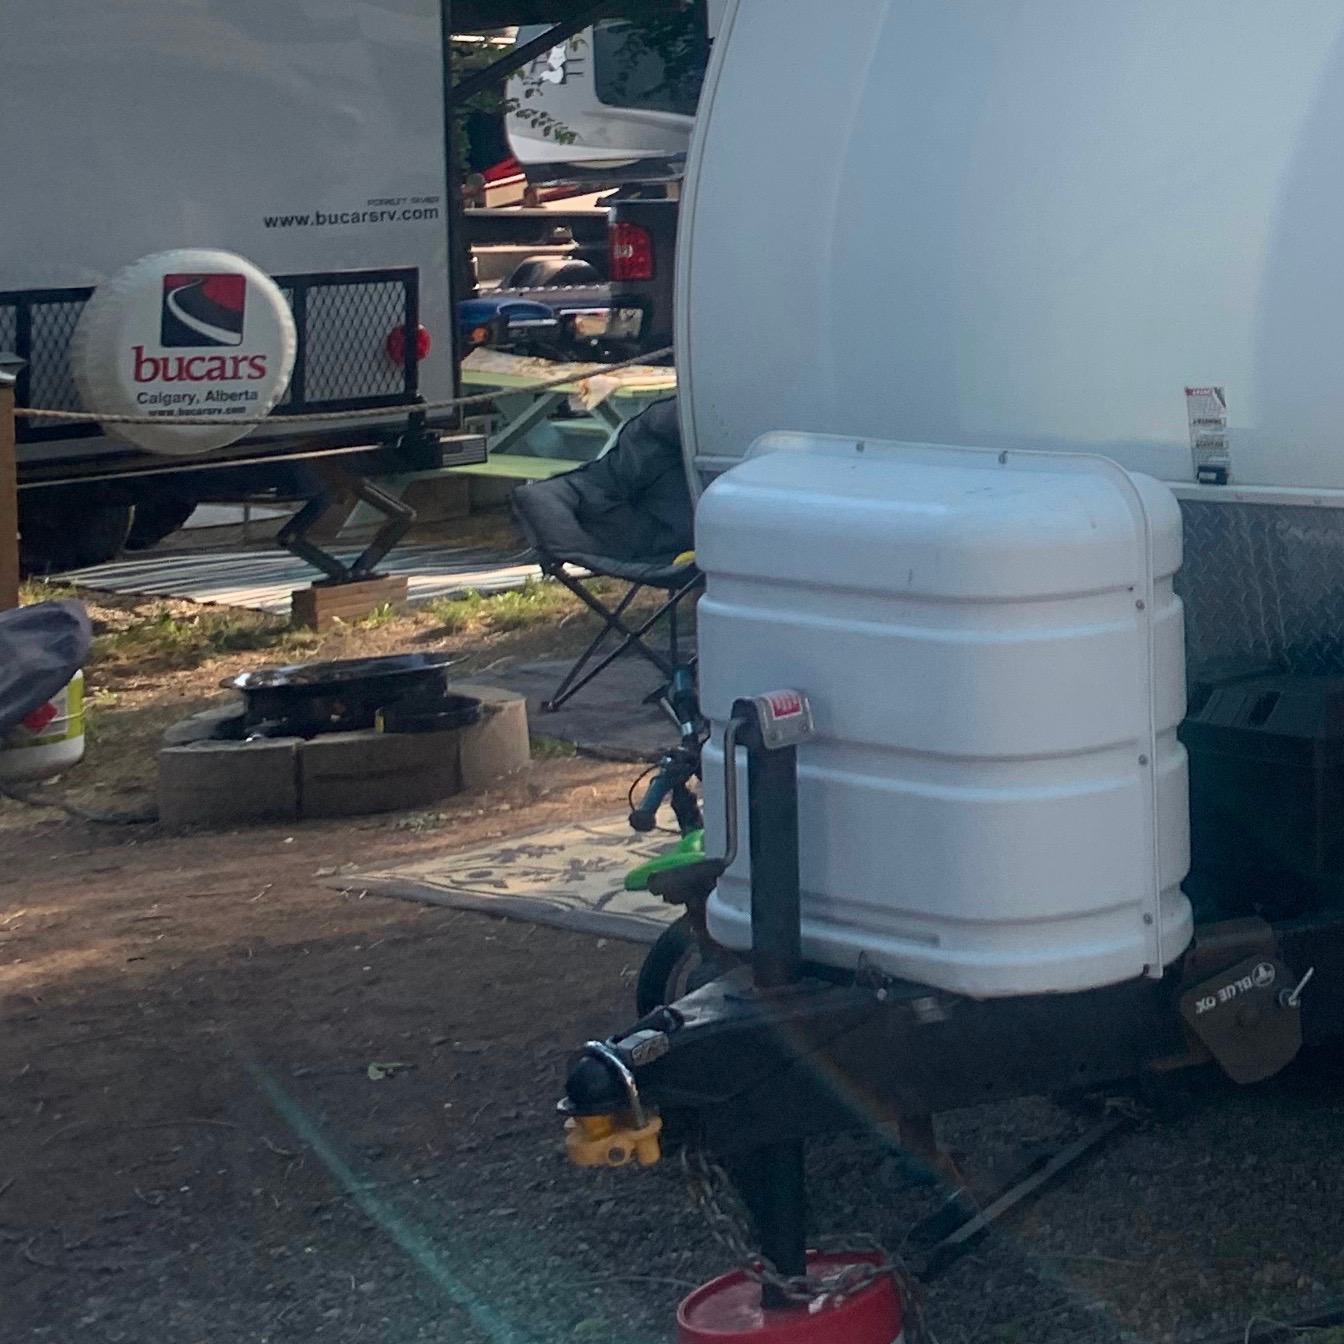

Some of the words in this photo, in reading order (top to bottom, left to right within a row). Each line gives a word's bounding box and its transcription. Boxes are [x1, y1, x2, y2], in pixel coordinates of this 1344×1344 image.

[262, 207, 440, 229] www.bucarsrv.com
[132, 345, 268, 383] bucars
[137, 391, 201, 406] Calgary,
[204, 389, 259, 405] Alberta
[1217, 975, 1253, 1003] BLUE
[1195, 996, 1217, 1014] OX
